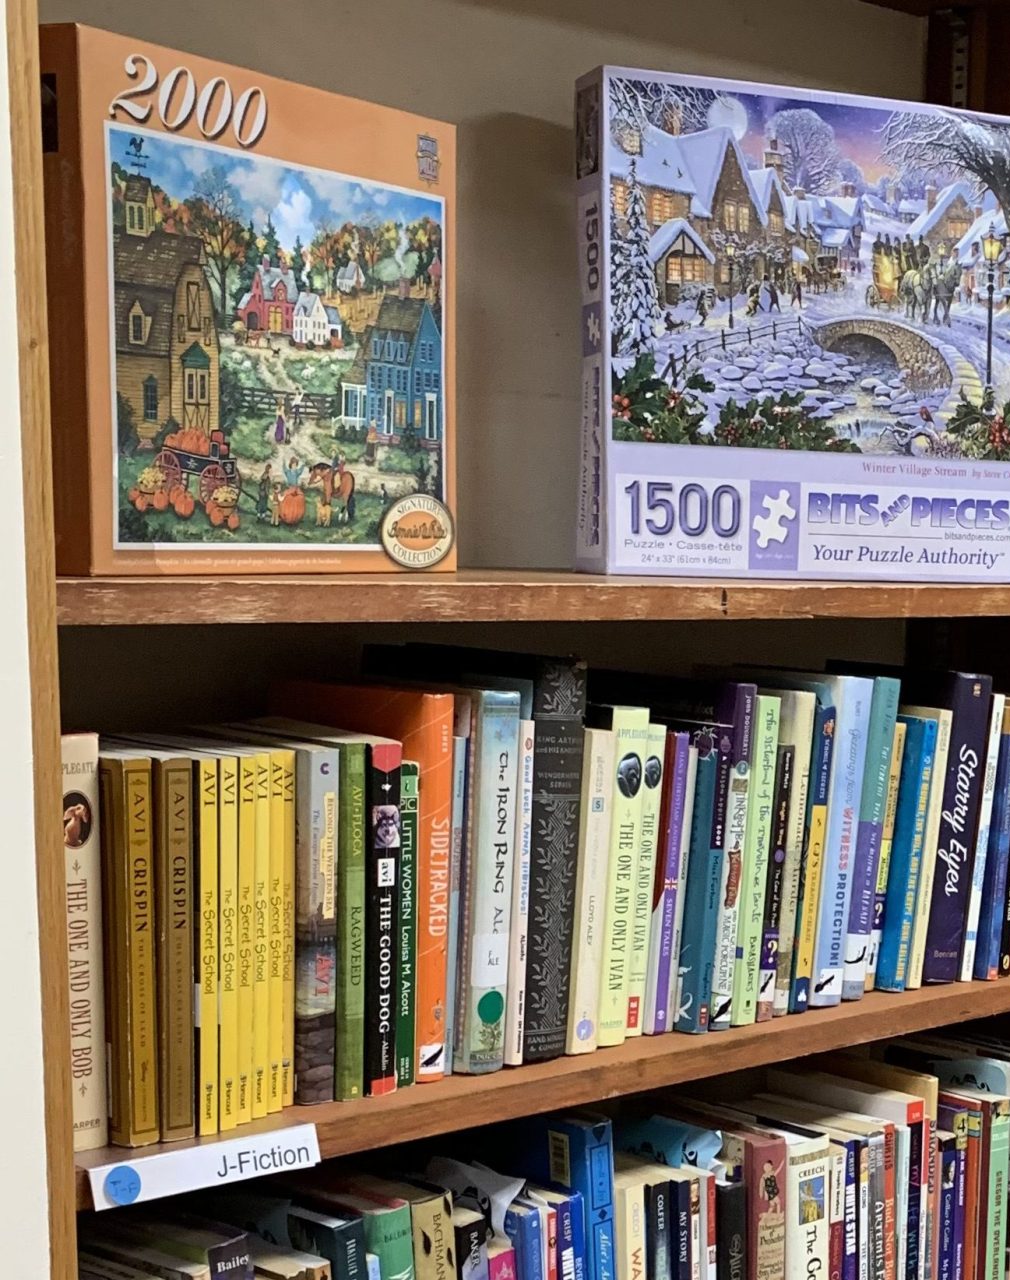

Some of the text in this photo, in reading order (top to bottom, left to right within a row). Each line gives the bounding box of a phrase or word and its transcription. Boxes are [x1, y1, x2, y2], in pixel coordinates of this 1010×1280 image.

[108, 53, 268, 148] 2000
[584, 202, 599, 291] 1500
[624, 480, 742, 538] 1500
[807, 492, 1010, 531] BITS AND PIECES
[624, 539, 742, 552] Puzzle Casse-tête
[813, 544, 854, 563] Your
[858, 545, 912, 565] Puzzle
[204, 770, 216, 806] AVI
[224, 770, 234, 805] AVI
[243, 768, 254, 803] AVI
[257, 764, 268, 800] AVI
[272, 762, 282, 798] AVI
[284, 769, 294, 803] AVI
[937, 744, 978, 897] Starry Eyes
[402, 819, 412, 862] LITTLE
[134, 794, 148, 932] AVI CRISPIN
[172, 793, 187, 930] AVI CRISPIN
[380, 862, 392, 884] avi
[428, 817, 450, 937] SIDETRACKED
[402, 864, 412, 920] WOMEN
[609, 823, 634, 990] THE ONE AND ONLY IVAN
[380, 894, 392, 931] THE
[662, 898, 673, 957] SEVEN TALES
[203, 891, 216, 994] The Secret School
[350, 906, 362, 986] RAGWEED
[402, 926, 412, 962] Louisa
[67, 879, 92, 1079] THE ONE AND ONLY BOB
[380, 936, 391, 990] GOOD
[379, 993, 390, 1034] DOG
[402, 980, 412, 1016] Alcott
[216, 1146, 311, 1178] J-Fiction
[656, 1194, 665, 1230] COLFER
[806, 1225, 817, 1254] The
[216, 1252, 250, 1274] Bailey
